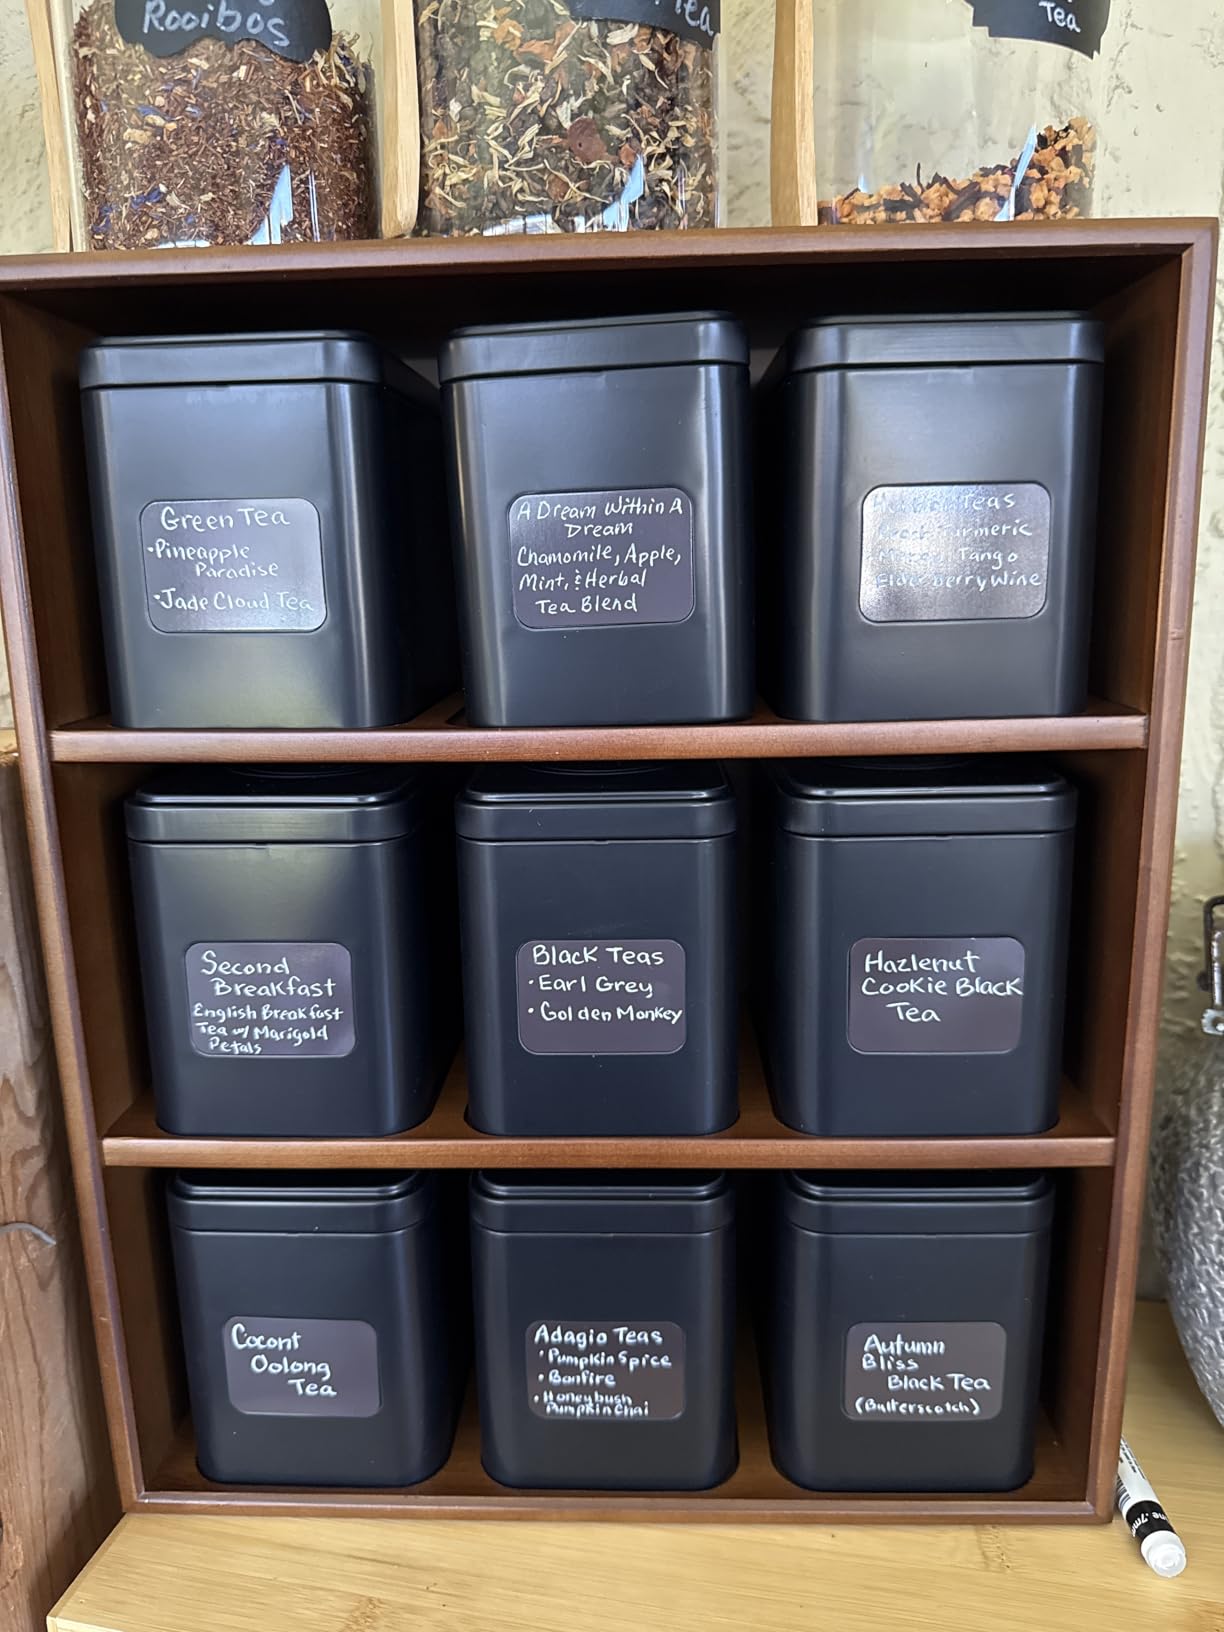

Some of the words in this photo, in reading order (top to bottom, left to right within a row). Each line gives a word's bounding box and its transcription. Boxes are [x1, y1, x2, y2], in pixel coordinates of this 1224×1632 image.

[144, 0, 290, 47] Rooibos
[1039, 0, 1081, 32] Tea
[161, 506, 234, 532] Green
[237, 508, 290, 526] Tea
[517, 502, 531, 520] A
[537, 501, 596, 520] Dream
[605, 496, 664, 516] Within
[669, 498, 683, 514] A
[564, 523, 633, 537] Dream
[155, 538, 250, 564] Pineapple
[517, 543, 620, 566] Chamomile,
[624, 543, 681, 567] Apple,
[195, 561, 279, 579] Paradise
[519, 572, 569, 591] Mint,
[585, 568, 647, 588] Herbal
[159, 588, 208, 611] Jade
[213, 592, 269, 610] Cloud
[276, 592, 314, 611] Tea
[535, 599, 576, 614] Tea
[582, 593, 637, 613] Blend
[201, 950, 290, 975] Second
[533, 944, 598, 966] Black
[605, 947, 664, 965] Teas
[865, 950, 981, 973] Hazlenut
[210, 976, 336, 996] Breakfast
[538, 975, 586, 992] Earl
[596, 976, 653, 998] Grey
[862, 977, 948, 995] Cookie
[956, 977, 1024, 997] Black
[194, 1003, 257, 1022] English
[262, 1004, 344, 1021] Breakfast
[540, 1001, 612, 1021] Golden
[617, 1005, 683, 1024] Monkey
[885, 1002, 941, 1022] Tea
[195, 1022, 228, 1036] Tea
[254, 1025, 328, 1047] Marigold
[209, 1036, 262, 1054] Petals
[534, 1324, 608, 1350] Adagio
[613, 1327, 663, 1344] Teas
[864, 1334, 945, 1355] Autumn
[251, 1354, 331, 1381] Oolong
[549, 1348, 615, 1370] Pumpkin
[618, 1351, 672, 1372] Spice
[862, 1353, 919, 1371] Bliss
[288, 1378, 337, 1396] Tea
[549, 1369, 616, 1387] Bonfire
[888, 1374, 944, 1391] Black
[946, 1373, 991, 1390] Tea
[614, 1401, 649, 1418] Chai
